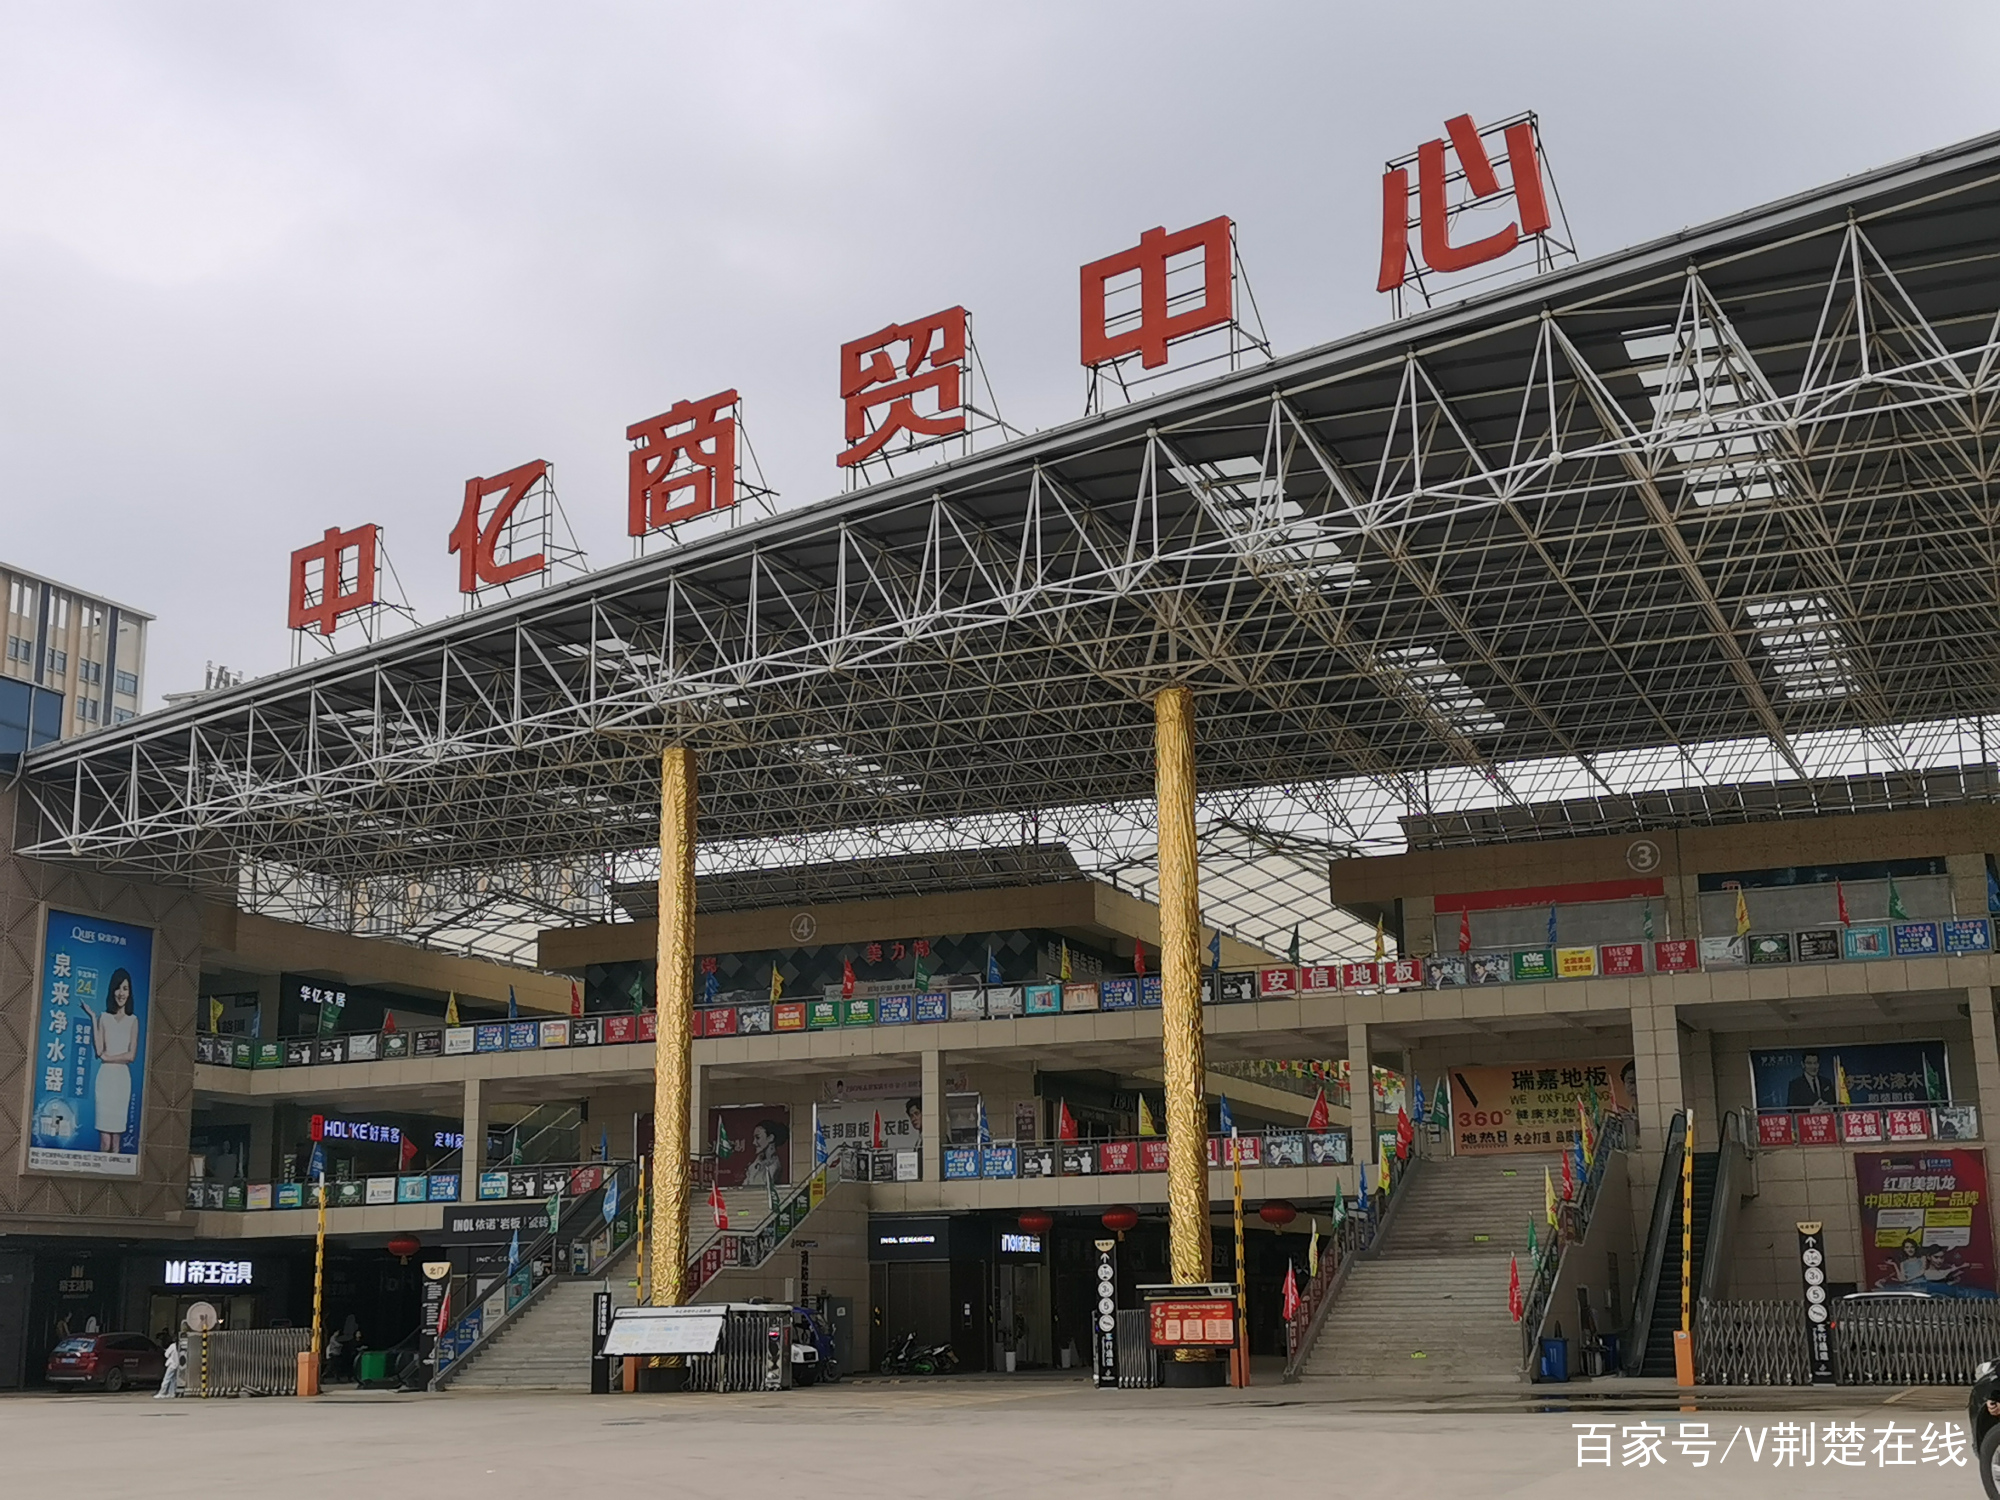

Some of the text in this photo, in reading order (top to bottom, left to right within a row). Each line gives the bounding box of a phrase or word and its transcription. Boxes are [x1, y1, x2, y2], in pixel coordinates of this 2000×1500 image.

[288, 113, 1550, 635] 中亿商贸中心
[1267, 961, 1415, 990] 安信地板
[300, 985, 347, 1008] 华亿家居
[45, 953, 71, 1092] 泉来净水器
[1511, 1065, 1609, 1090] 瑞嘉地板
[1848, 1111, 1876, 1124] 安信
[1894, 1110, 1922, 1124] 安信
[368, 1126, 400, 1144] 好莱客
[884, 1118, 909, 1136] 衣柜
[1849, 1123, 1877, 1136] 地板
[1894, 1122, 1923, 1135] 地板
[1882, 1175, 1956, 1192] 红星美凯龙
[1864, 1191, 1979, 1208] 中国家居第一品牌
[188, 1261, 253, 1285] 帝王洁具
